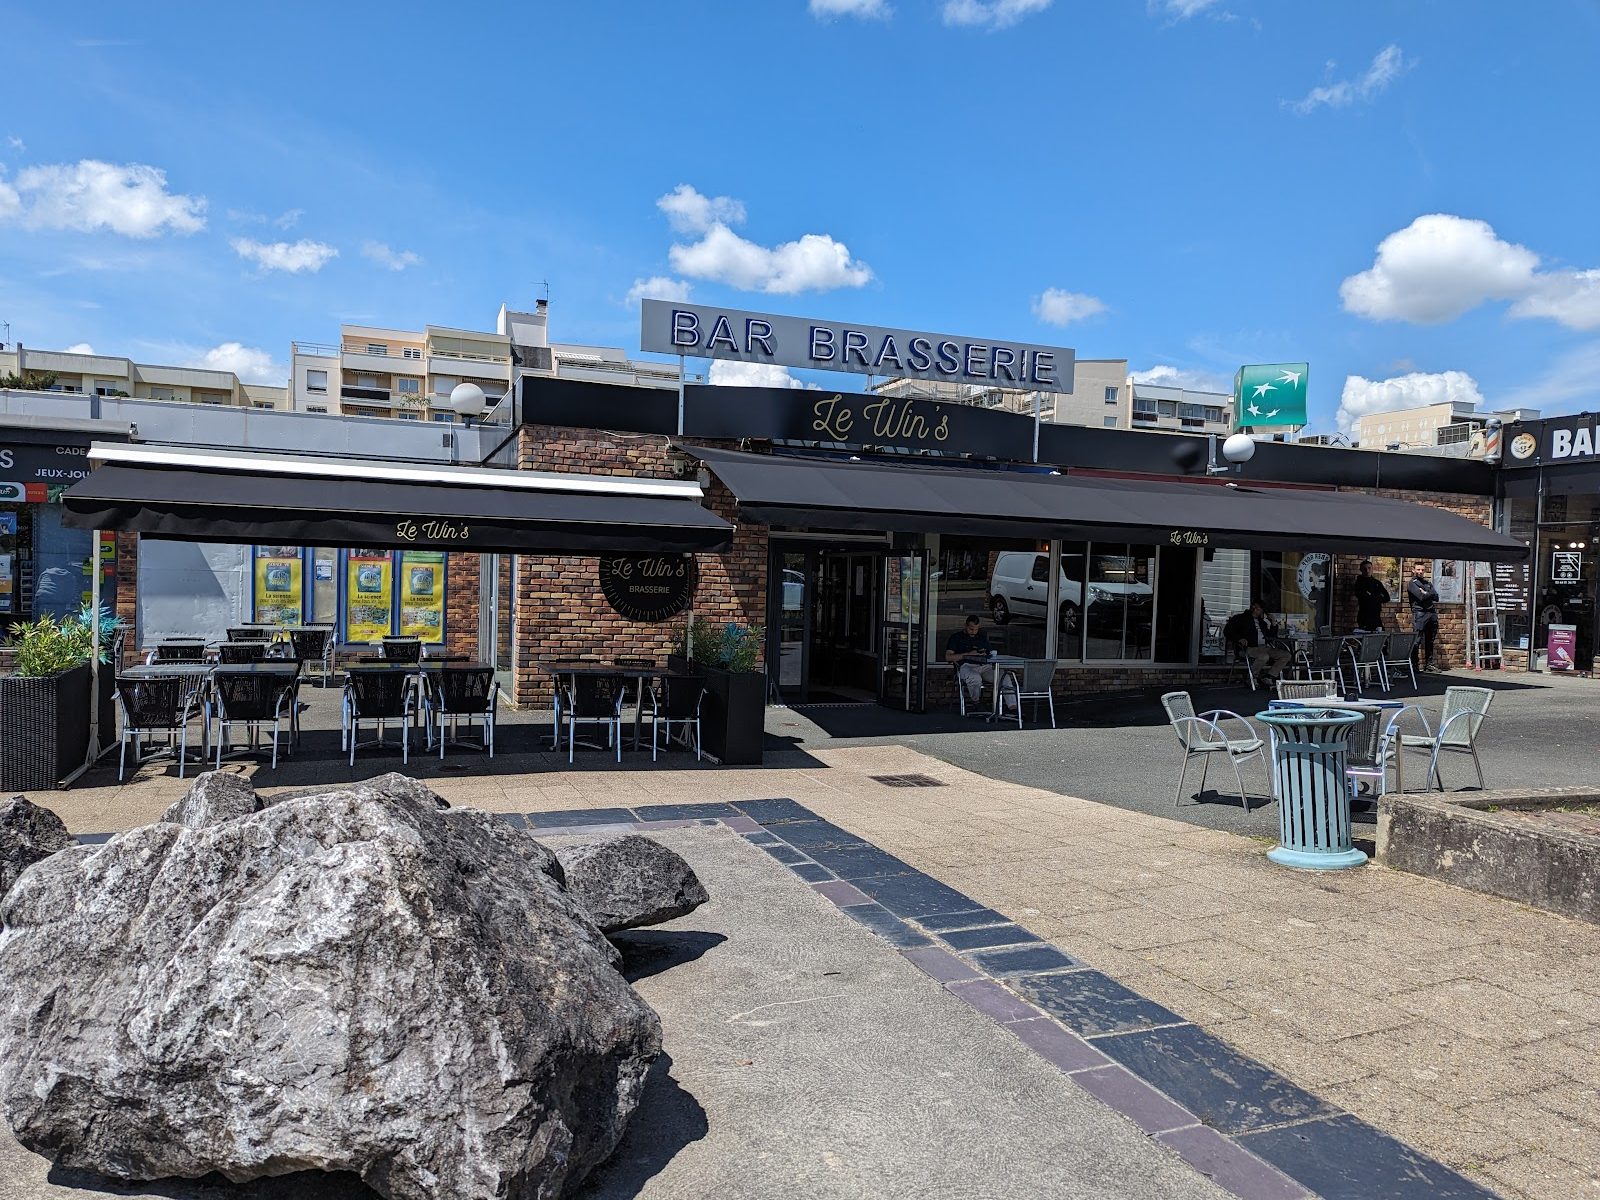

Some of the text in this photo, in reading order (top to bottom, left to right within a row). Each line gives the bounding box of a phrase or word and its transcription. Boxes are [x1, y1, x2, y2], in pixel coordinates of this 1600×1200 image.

[671, 309, 1054, 384] BAR BRASSERIE
[813, 394, 949, 440] Le Win's
[55, 446, 87, 456] CADE
[1552, 425, 1600, 458] BA
[396, 520, 469, 541] Le Win's
[1170, 530, 1209, 546] Le Win's
[611, 557, 685, 579] Le Win's
[629, 585, 670, 594] BRASSERIE
